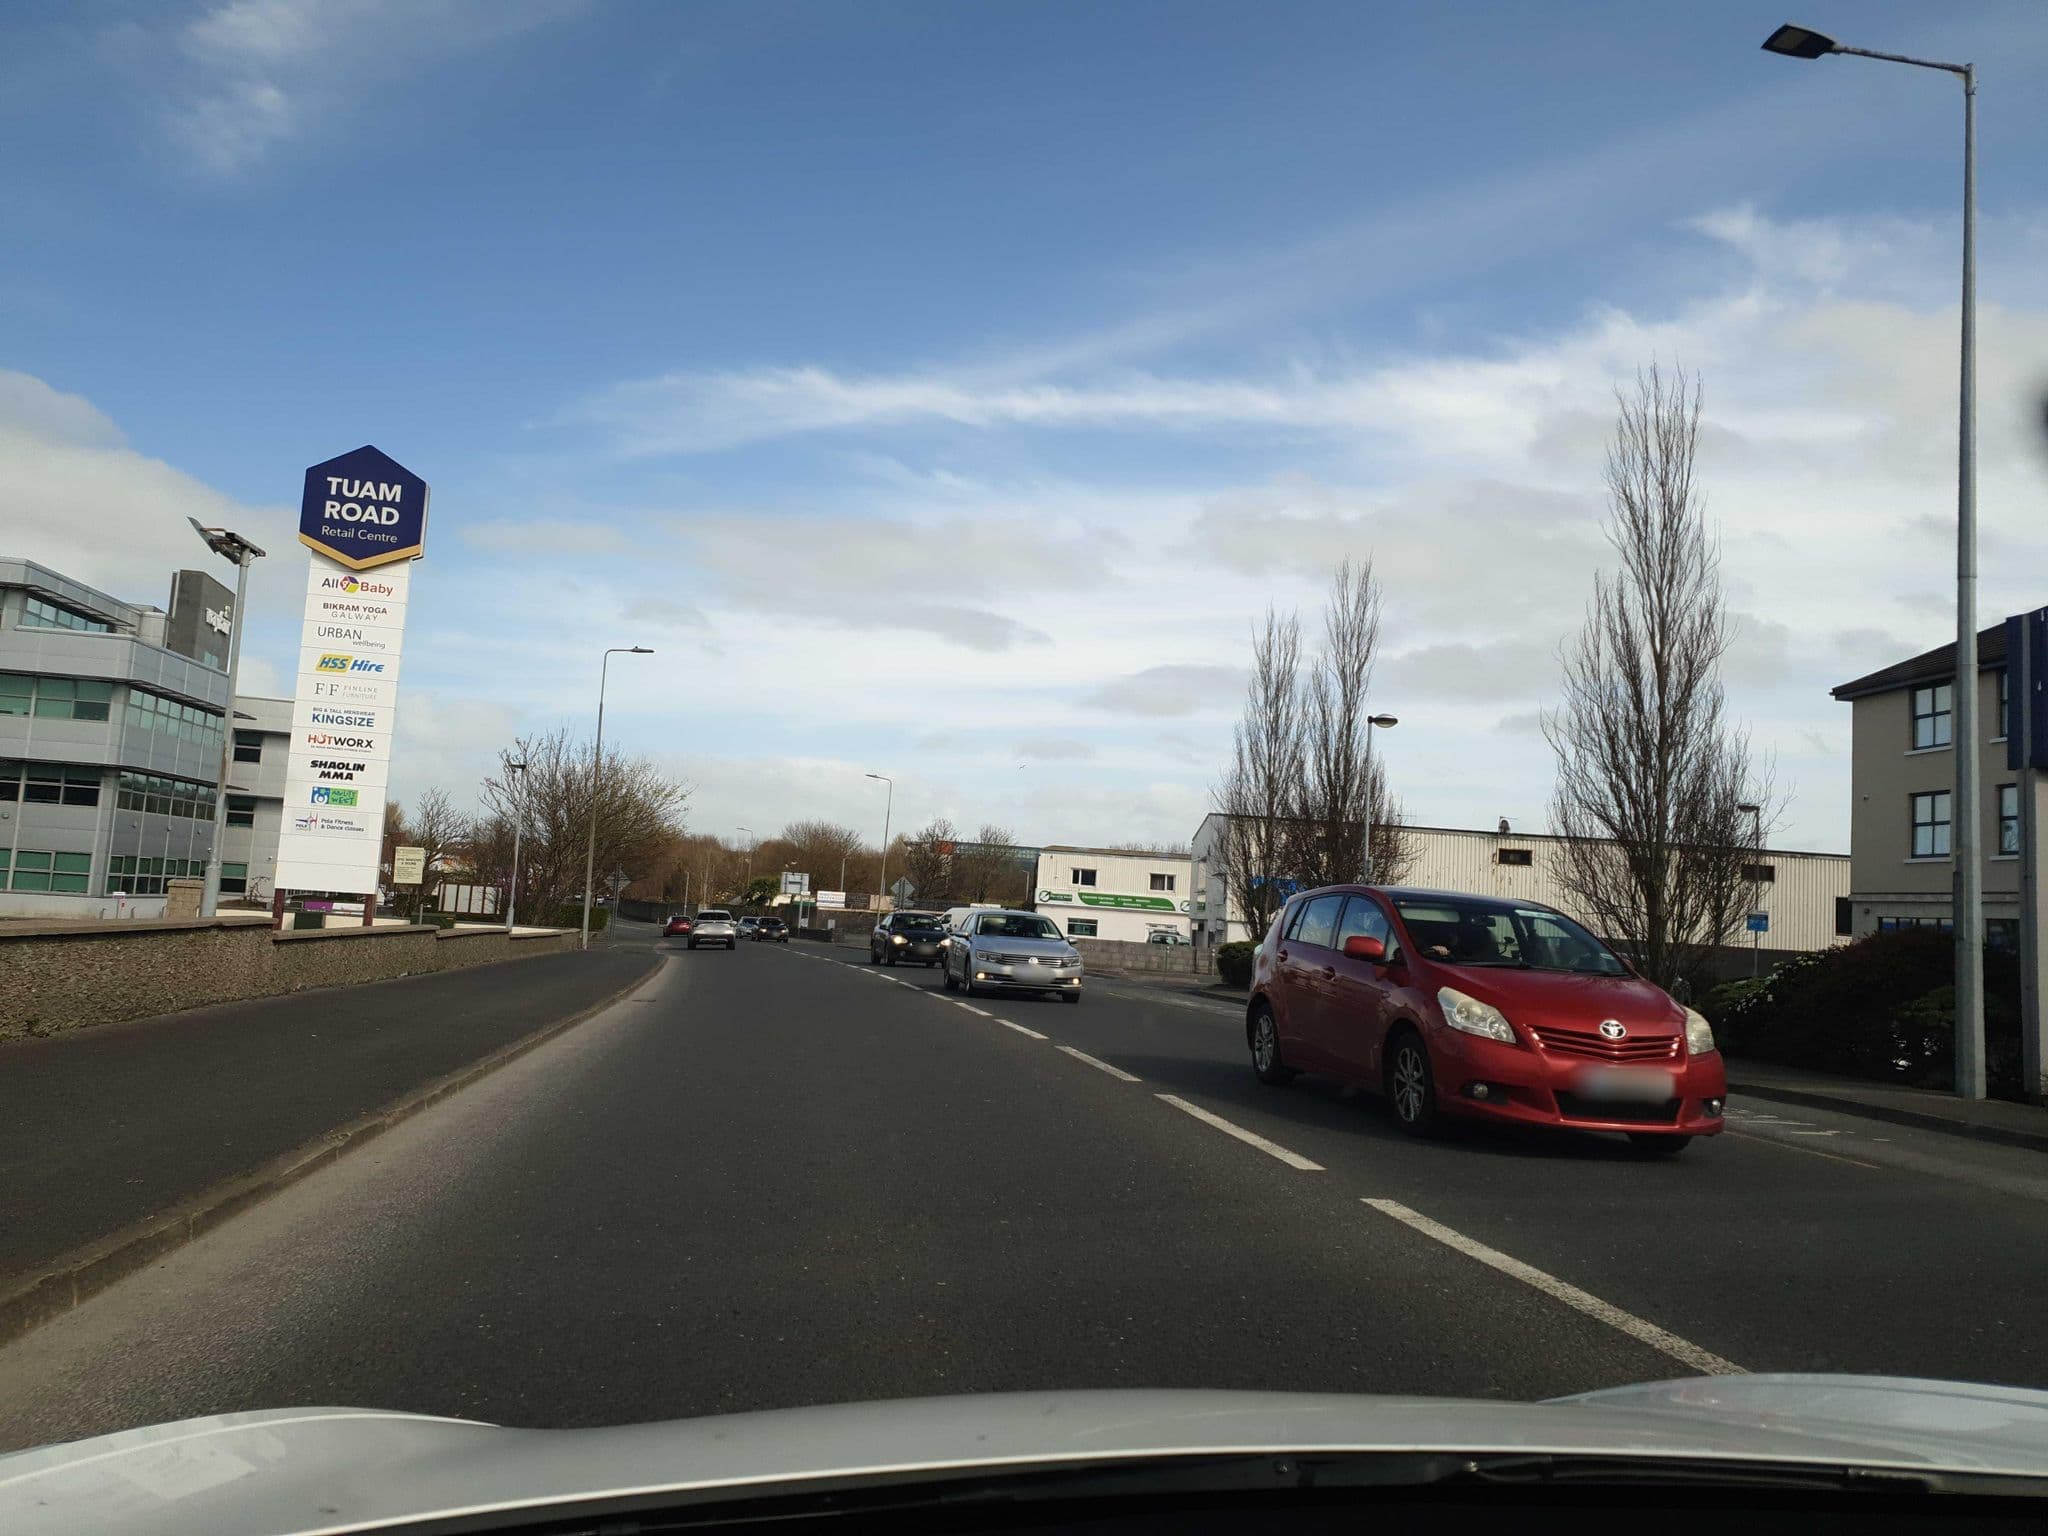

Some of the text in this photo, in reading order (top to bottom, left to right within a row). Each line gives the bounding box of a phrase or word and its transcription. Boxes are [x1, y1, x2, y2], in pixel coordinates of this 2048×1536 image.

[327, 476, 402, 502] TUAM
[324, 500, 400, 525] ROAD
[321, 525, 398, 543] Retail Centre
[322, 578, 339, 588] All
[360, 581, 394, 596] Baby
[323, 602, 388, 614] BIKRAM YOGA
[331, 611, 378, 621] GALWAY
[317, 626, 362, 640] URBAN
[352, 639, 386, 650] wellbeing
[319, 657, 385, 673] HSS Hire
[311, 713, 375, 728] KINGSIZE
[307, 732, 375, 749] HOTWORX
[310, 759, 366, 772] SHAOLIN
[318, 770, 354, 781] MMA
